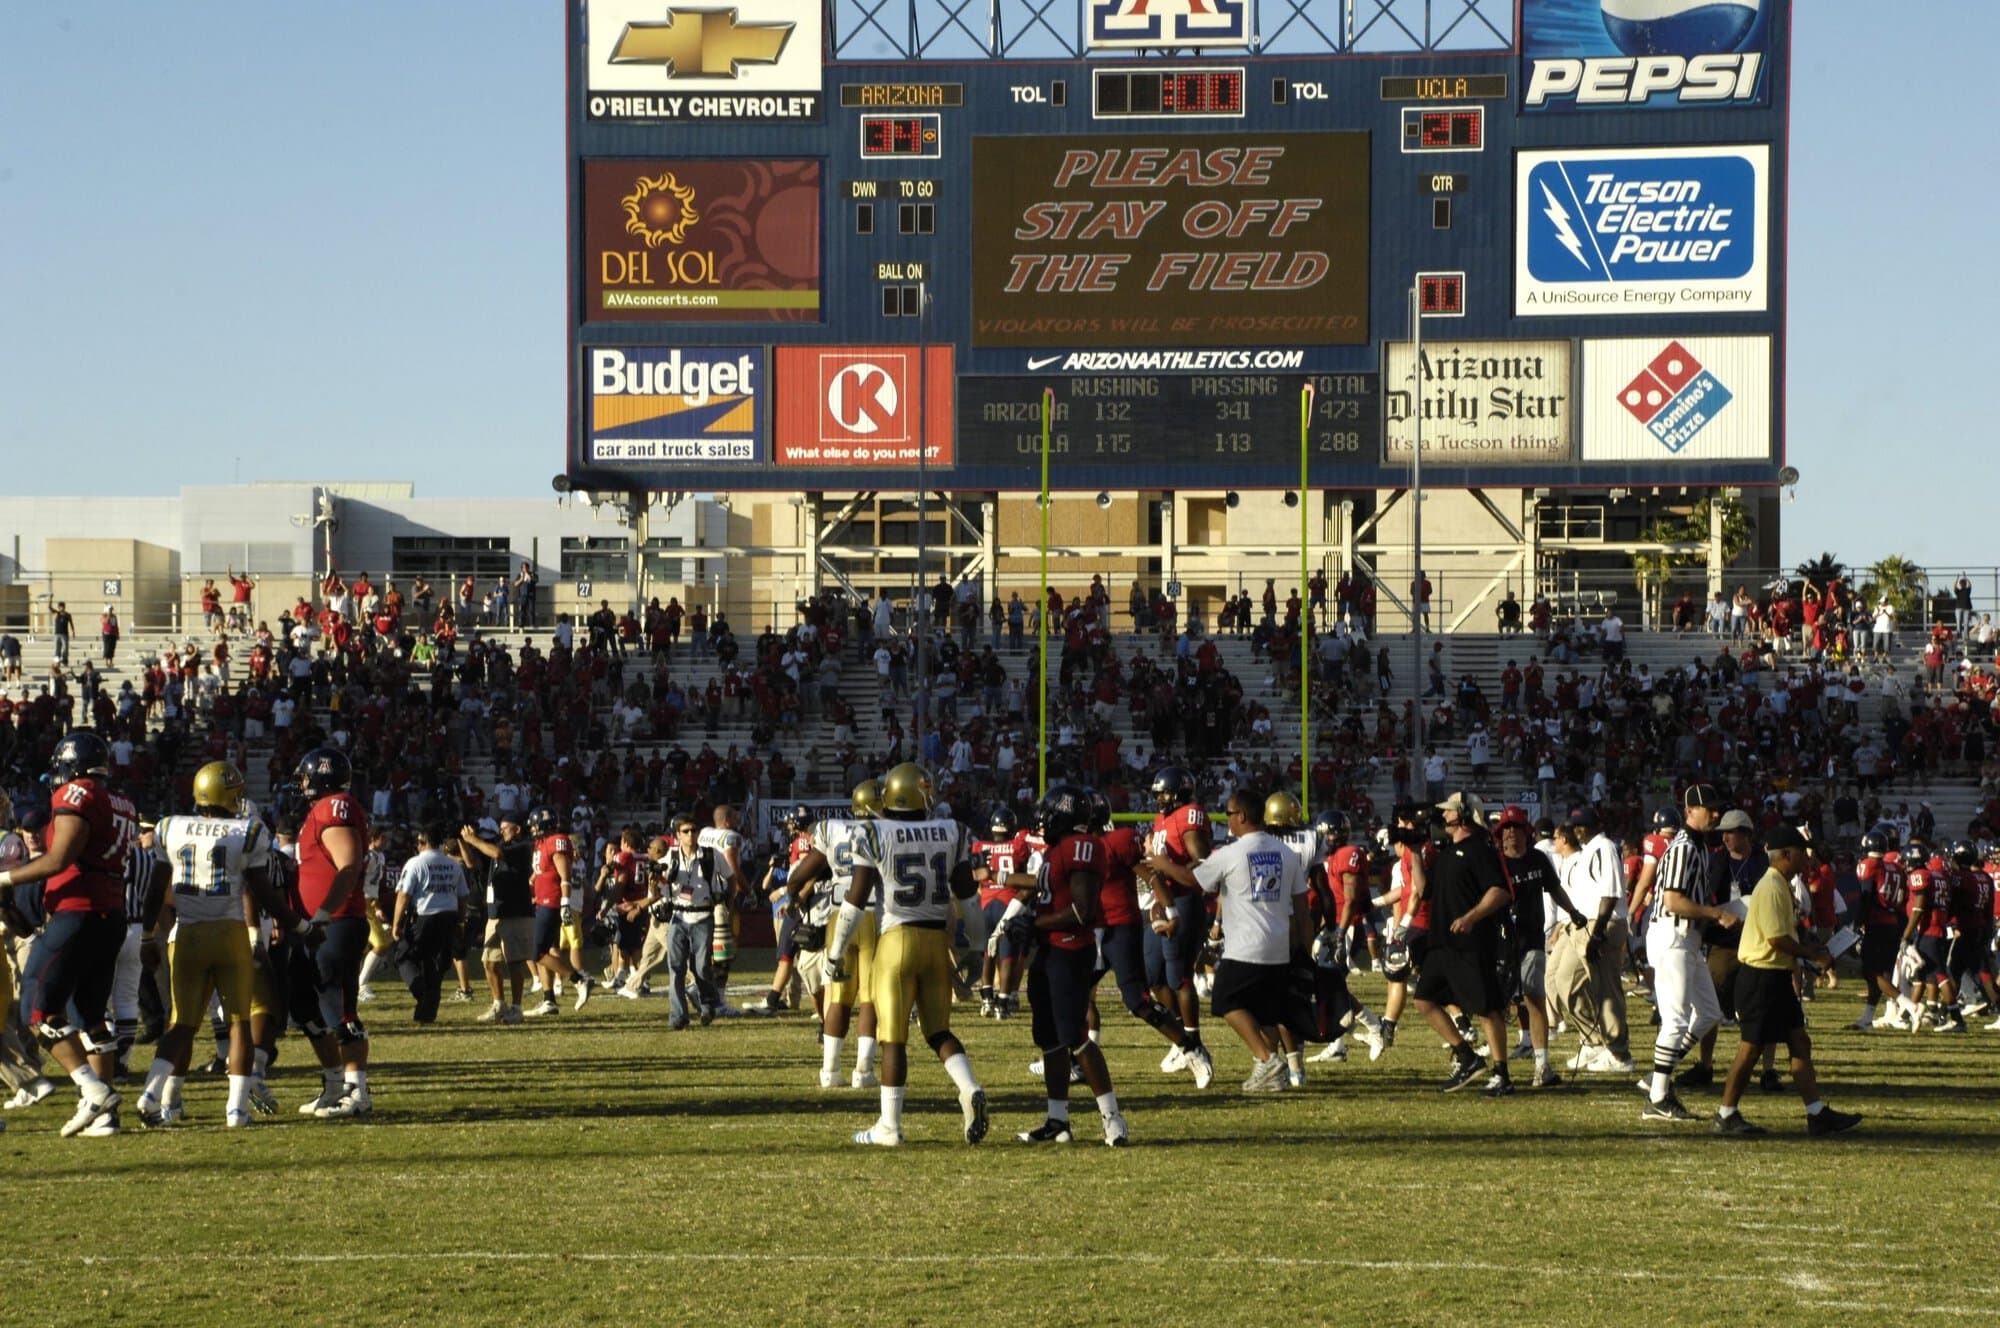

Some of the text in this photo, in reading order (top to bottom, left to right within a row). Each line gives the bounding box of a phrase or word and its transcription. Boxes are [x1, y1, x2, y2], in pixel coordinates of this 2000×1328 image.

[1417, 78, 1467, 98] UCLA
[1525, 52, 1762, 105] PEPSI
[861, 86, 943, 105] ARIZONA
[1011, 87, 1046, 103] TOL
[1292, 83, 1328, 99] TOL
[590, 97, 815, 117] O'RIELLY CHEVROLET
[1423, 112, 1480, 145] 27
[1054, 147, 1285, 188] PLEASE
[852, 183, 877, 198] DWN
[900, 182, 934, 197] TO GO
[1432, 175, 1453, 192] QTR
[1585, 173, 1702, 204] Tucson
[1015, 199, 1323, 240] STAY OFF
[1596, 203, 1733, 233] Electric
[1609, 236, 1732, 264] Power
[602, 251, 721, 284] DEL SOL
[878, 263, 923, 279] BALL ON
[1004, 251, 1330, 292] THE FIELD
[606, 293, 719, 306] AVAconcerts.com
[1526, 288, 1753, 305] A UniSource Energy Company
[978, 315, 1360, 334] VIOLATORS WILL BE PROSECUTED
[1062, 350, 1304, 370] ARIZONAATHLETICS.COM
[1405, 347, 1544, 382] Arizona
[593, 349, 754, 409] Budget
[1071, 378, 1160, 397] RUSHING
[1191, 376, 1278, 395] PASSING
[983, 401, 1360, 422] ARIZOA 132 341 473
[1385, 386, 1566, 428] Daily Star
[1650, 378, 1713, 438] Domino's
[1663, 411, 1706, 450] Pizza
[596, 441, 751, 456] car and truck sales
[1319, 432, 1360, 451] 288
[1438, 435, 1503, 450] Tucson
[1511, 434, 1564, 453] thing.
[785, 447, 820, 459] What
[823, 447, 850, 459] else
[853, 447, 870, 459] do
[873, 448, 897, 461] you
[105, 580, 118, 595] 26
[579, 582, 591, 595] 27
[1169, 582, 1181, 595] 28
[1775, 578, 1788, 594] 29
[1520, 791, 1538, 802] 29
[330, 798, 350, 820] 75
[186, 823, 230, 838] KEYES
[896, 828, 948, 844] CARTER
[1072, 841, 1092, 863] 10
[175, 844, 231, 896] 11
[894, 852, 951, 907] 51
